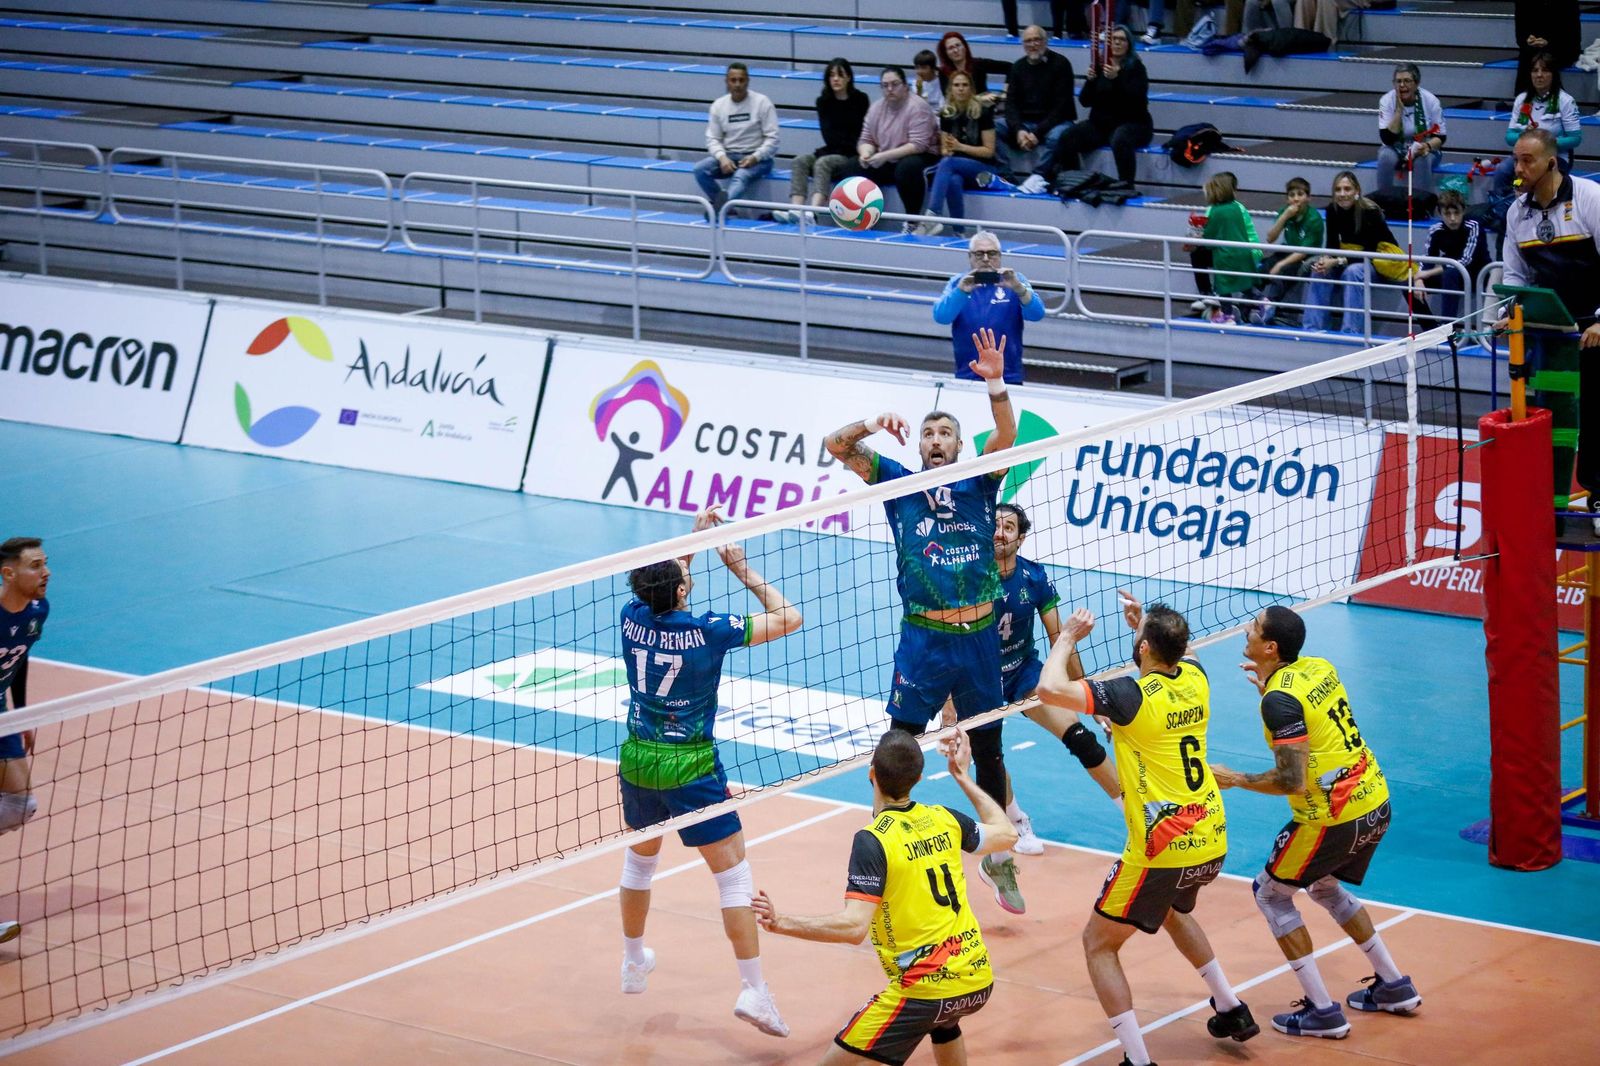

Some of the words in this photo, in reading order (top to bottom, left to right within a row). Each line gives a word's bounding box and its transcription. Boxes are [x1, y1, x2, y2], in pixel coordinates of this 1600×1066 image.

[0, 322, 178, 392] macron
[344, 337, 505, 406] Andalucía
[695, 422, 805, 465] COSTA
[1066, 476, 1251, 559] Unicaja
[945, 546, 970, 556] COSTA
[1410, 566, 1484, 595] SUPERL
[622, 617, 656, 647] PAULO
[660, 628, 706, 651] RENAN
[631, 648, 683, 697] 17
[1327, 697, 1362, 752] 13
[1179, 735, 1205, 792] 6
[1168, 837, 1207, 853] nexus
[925, 863, 961, 917] 4
